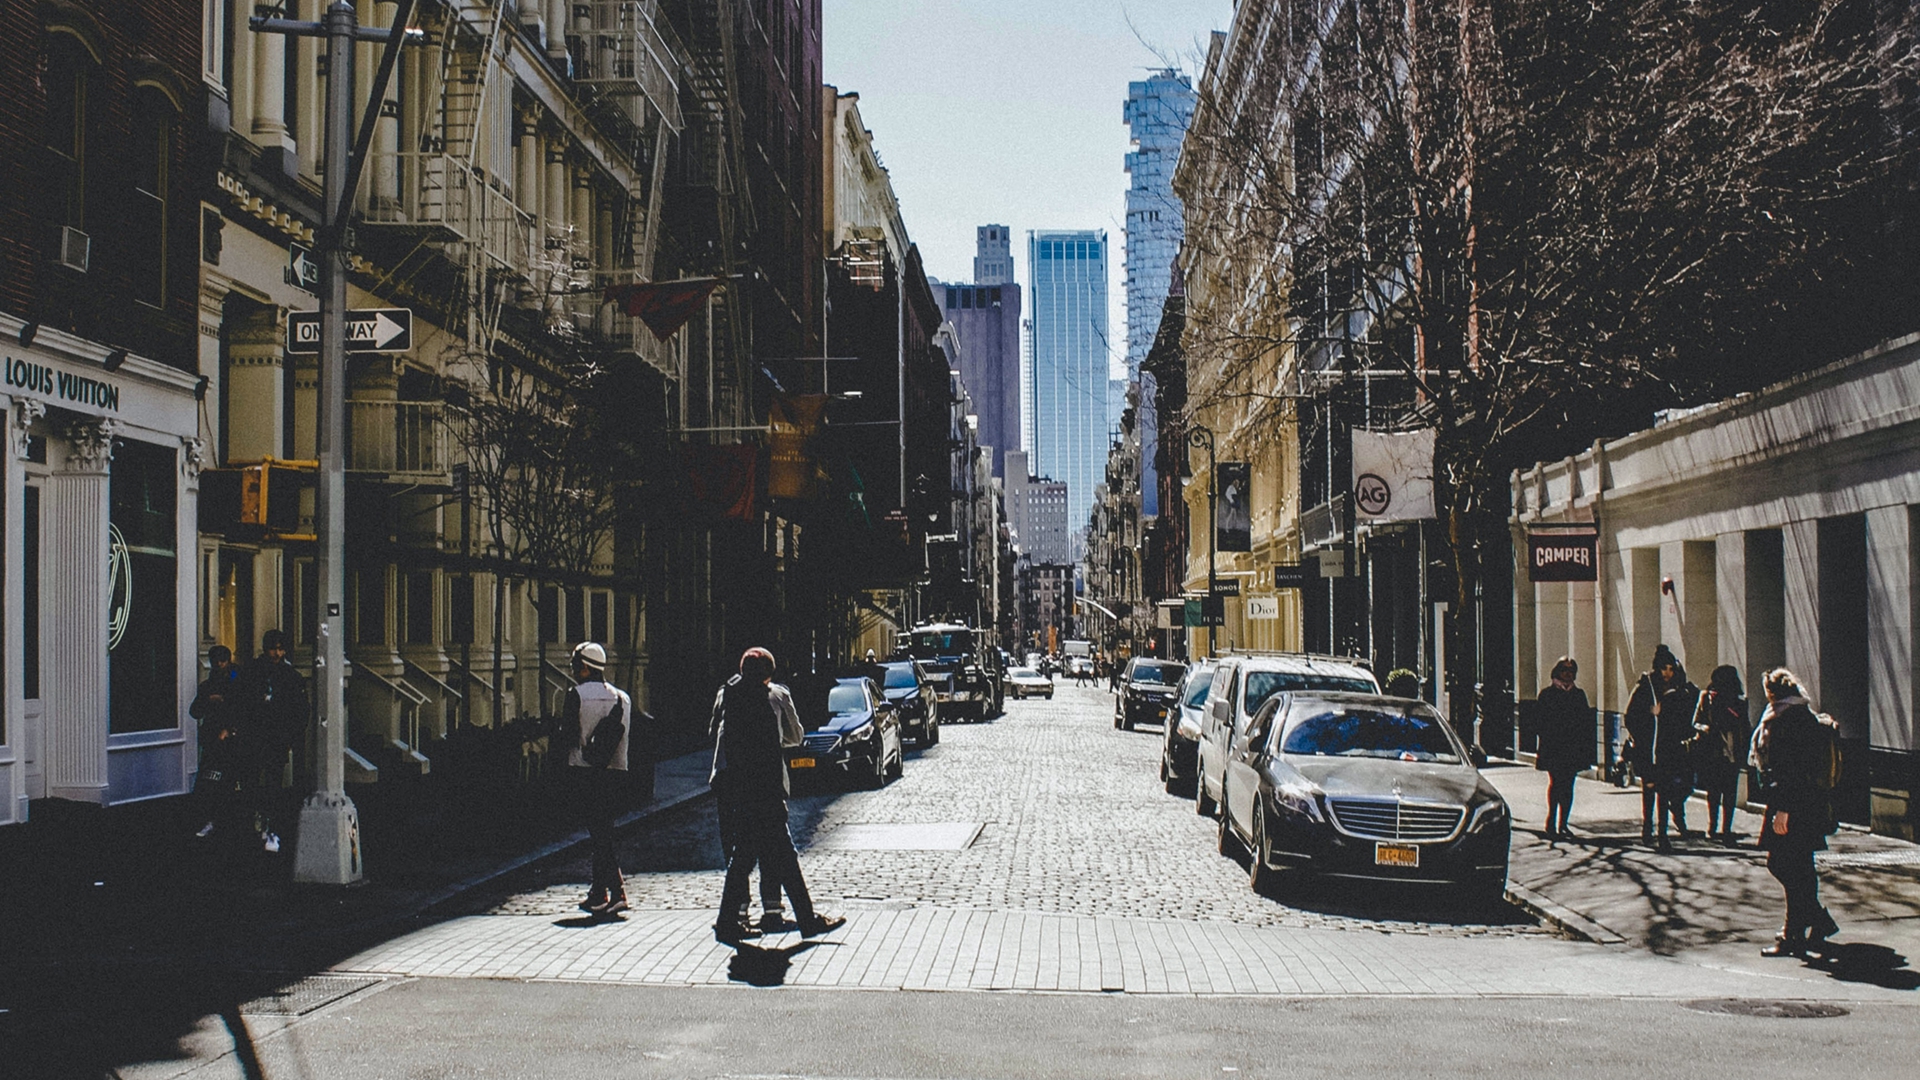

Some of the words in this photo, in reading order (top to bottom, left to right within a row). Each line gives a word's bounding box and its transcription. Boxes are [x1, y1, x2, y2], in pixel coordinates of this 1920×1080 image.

[301, 324, 319, 340] ON
[6, 356, 54, 395] LOUIS
[57, 370, 120, 412] VUITTON
[1360, 486, 1386, 504] AG
[1535, 546, 1590, 567] CAMPER
[1214, 584, 1238, 592] SONOS
[1250, 602, 1276, 616] Dior
